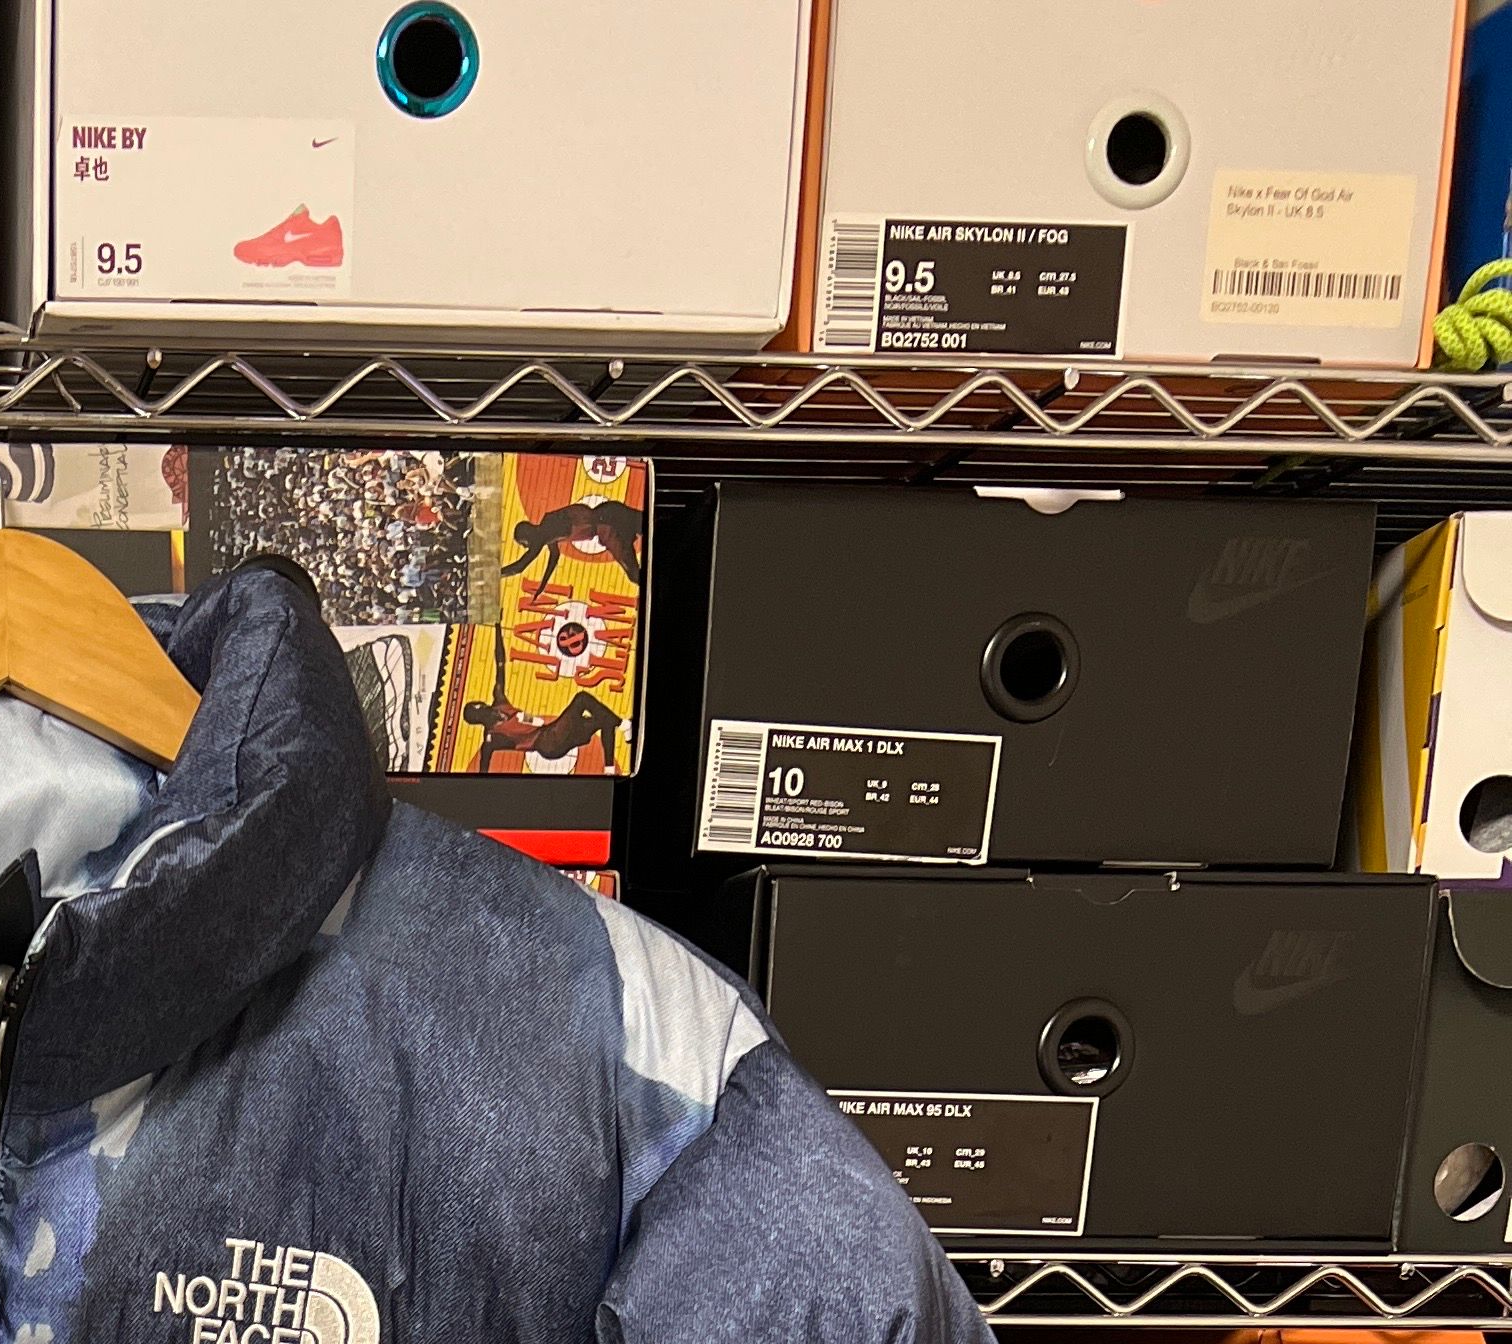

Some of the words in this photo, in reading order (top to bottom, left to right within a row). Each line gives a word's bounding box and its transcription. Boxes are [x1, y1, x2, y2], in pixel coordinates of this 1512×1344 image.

[72, 126, 117, 150] NIKE
[121, 127, 147, 150] BY
[890, 224, 924, 241] NIKE
[926, 226, 952, 242] AIR
[955, 227, 1014, 244] SKYLON
[1038, 229, 1069, 245] FOG
[97, 242, 143, 275] 9.5
[885, 260, 936, 294] 9.5
[881, 331, 938, 348] BQ2752
[941, 333, 968, 349] 001
[510, 577, 574, 682] JAM
[575, 588, 639, 693] SLAM
[772, 734, 805, 750] NIKE
[806, 735, 831, 751] AIR
[833, 736, 863, 752] MAX
[866, 741, 874, 752] 1
[876, 740, 904, 755] DLX
[768, 767, 805, 797] 10
[761, 831, 814, 848] AQ0928
[818, 833, 843, 849] 700
[867, 1103, 891, 1116] AIR
[893, 1103, 925, 1117] MAX
[926, 1104, 943, 1117] 95
[944, 1105, 973, 1118] DLX
[225, 1237, 316, 1289] THE
[153, 1271, 306, 1329] NORTH
